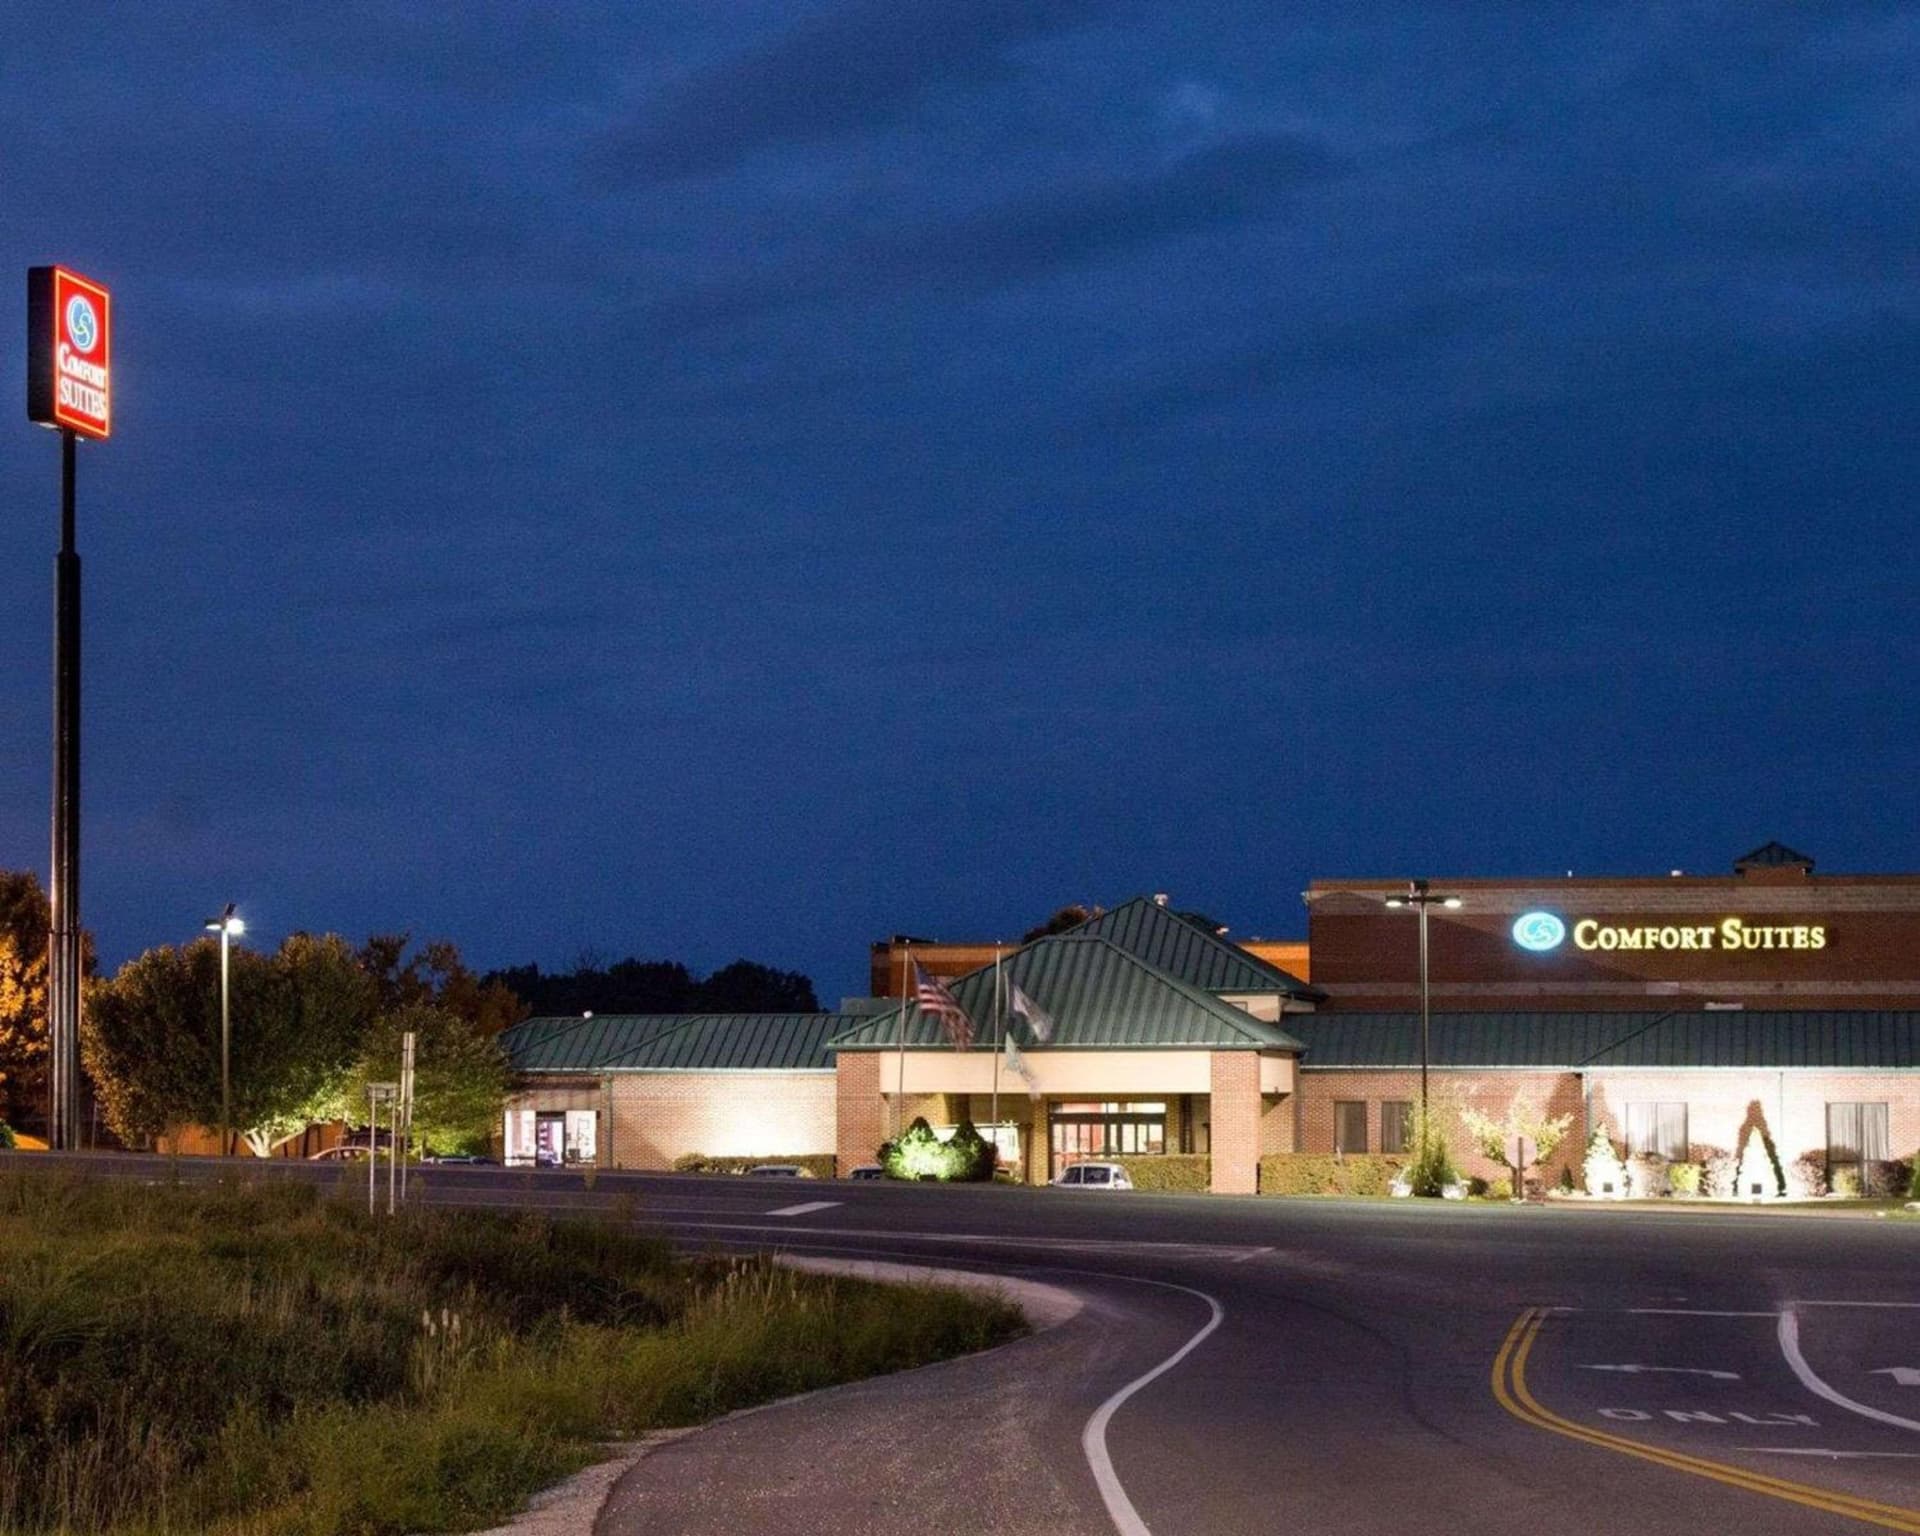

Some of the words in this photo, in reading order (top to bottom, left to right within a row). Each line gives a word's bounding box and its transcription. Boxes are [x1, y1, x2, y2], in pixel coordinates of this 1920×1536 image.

[59, 376, 106, 421] SUITES
[1574, 919, 1715, 950] COMFORT
[1721, 918, 1826, 950] SUITES
[1597, 1408, 1821, 1427] ONLY
